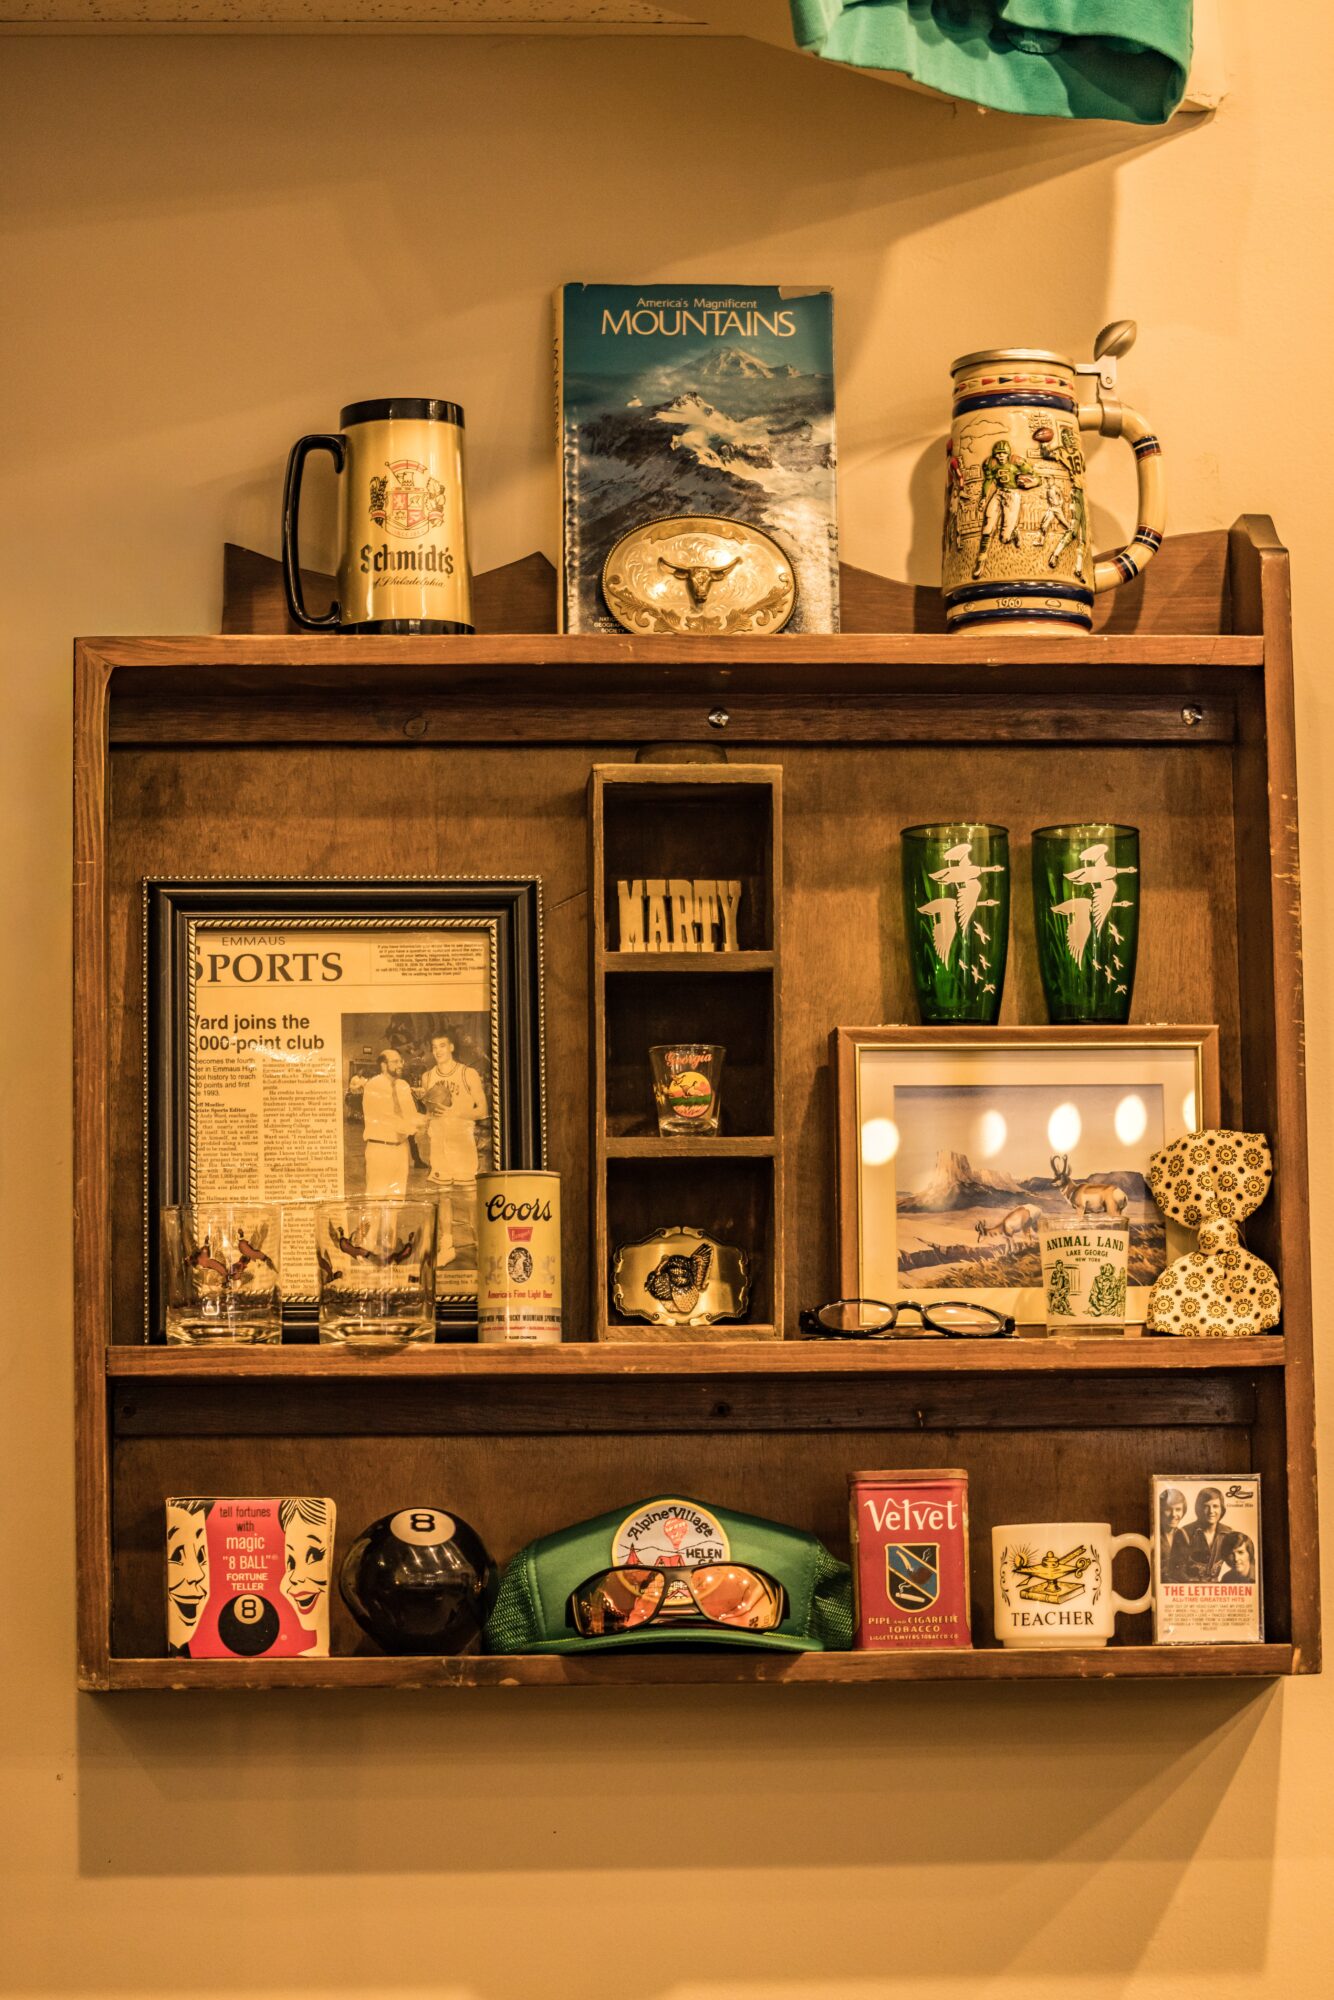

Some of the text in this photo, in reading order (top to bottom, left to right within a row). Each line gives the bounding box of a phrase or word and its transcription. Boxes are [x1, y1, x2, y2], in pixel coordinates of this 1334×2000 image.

[636, 298, 758, 310] America's Magnificent
[602, 310, 796, 336] MOUNTAINS
[998, 468, 1009, 483] 5
[360, 544, 454, 578] Schmidt's
[996, 598, 1022, 608] 1960
[617, 880, 742, 952] MARTY
[222, 936, 286, 946] EMMAUS
[196, 1014, 310, 1034] ard joins the
[286, 1034, 324, 1050] club
[664, 1051, 712, 1070] Georgia
[486, 1194, 552, 1222] Coors
[1046, 1236, 1124, 1251] ANIMAL LAND
[514, 1290, 525, 1298] Fine
[528, 1290, 541, 1299] Light
[220, 1506, 271, 1517] tell fortunes
[864, 1498, 958, 1532] Velvet
[236, 1520, 254, 1532] with
[410, 1513, 435, 1532] 8
[627, 1506, 714, 1541] Alpine Village
[226, 1534, 265, 1552] magic
[686, 1548, 722, 1559] HELEN
[226, 1573, 268, 1581] FORTUNE
[231, 1582, 264, 1591] TELLER
[1164, 1586, 1252, 1596] THE LETTERMEN
[241, 1599, 256, 1618] 8
[907, 1615, 958, 1624] CIGARETTE
[1011, 1611, 1094, 1627] TEACHER
